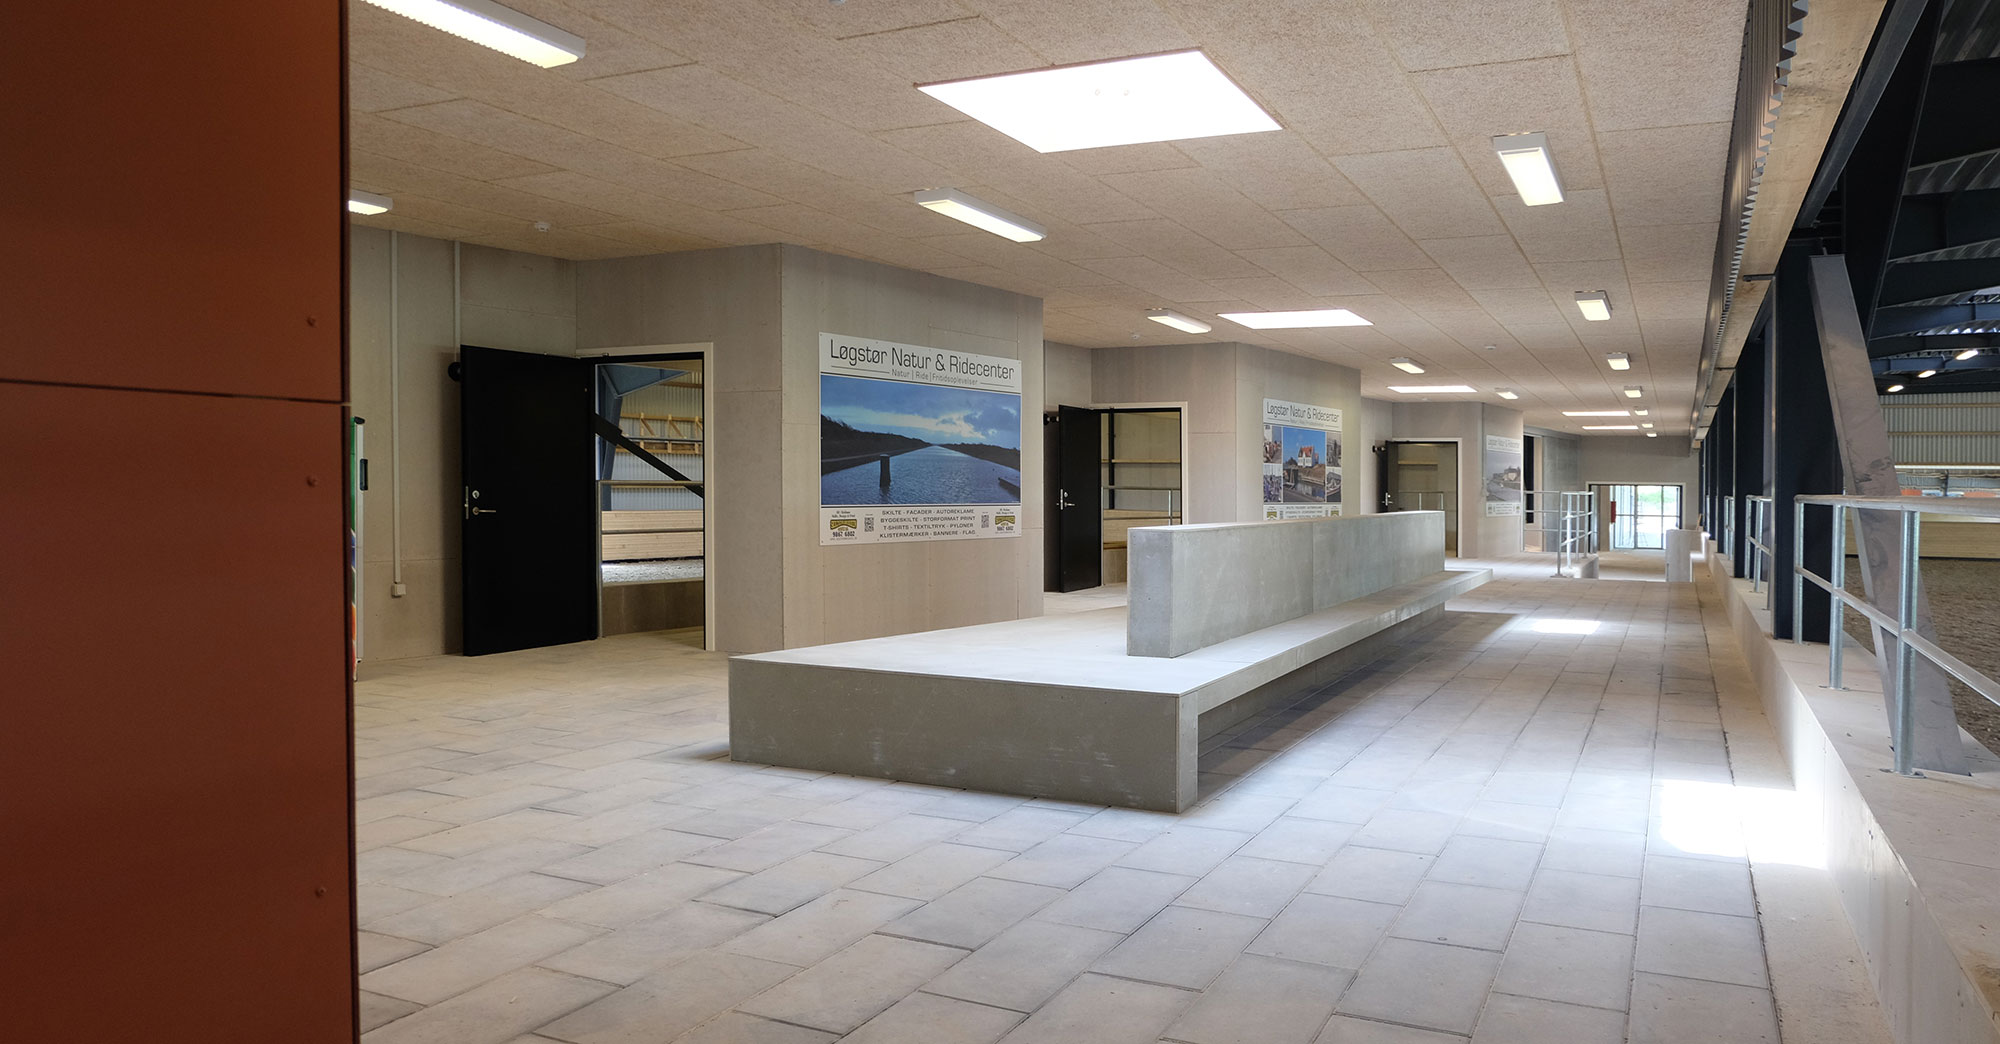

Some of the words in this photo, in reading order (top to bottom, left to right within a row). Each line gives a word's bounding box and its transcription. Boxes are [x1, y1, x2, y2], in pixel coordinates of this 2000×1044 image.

[830, 339, 887, 366] Løgstør
[891, 347, 931, 370] Natur
[935, 353, 946, 372] &
[949, 355, 1015, 380] Ridecenter
[891, 369, 910, 378] Natur
[915, 371, 929, 380] Ride
[1289, 405, 1306, 418] Natur
[1306, 407, 1312, 419] &
[1312, 408, 1340, 422] Ridecenter
